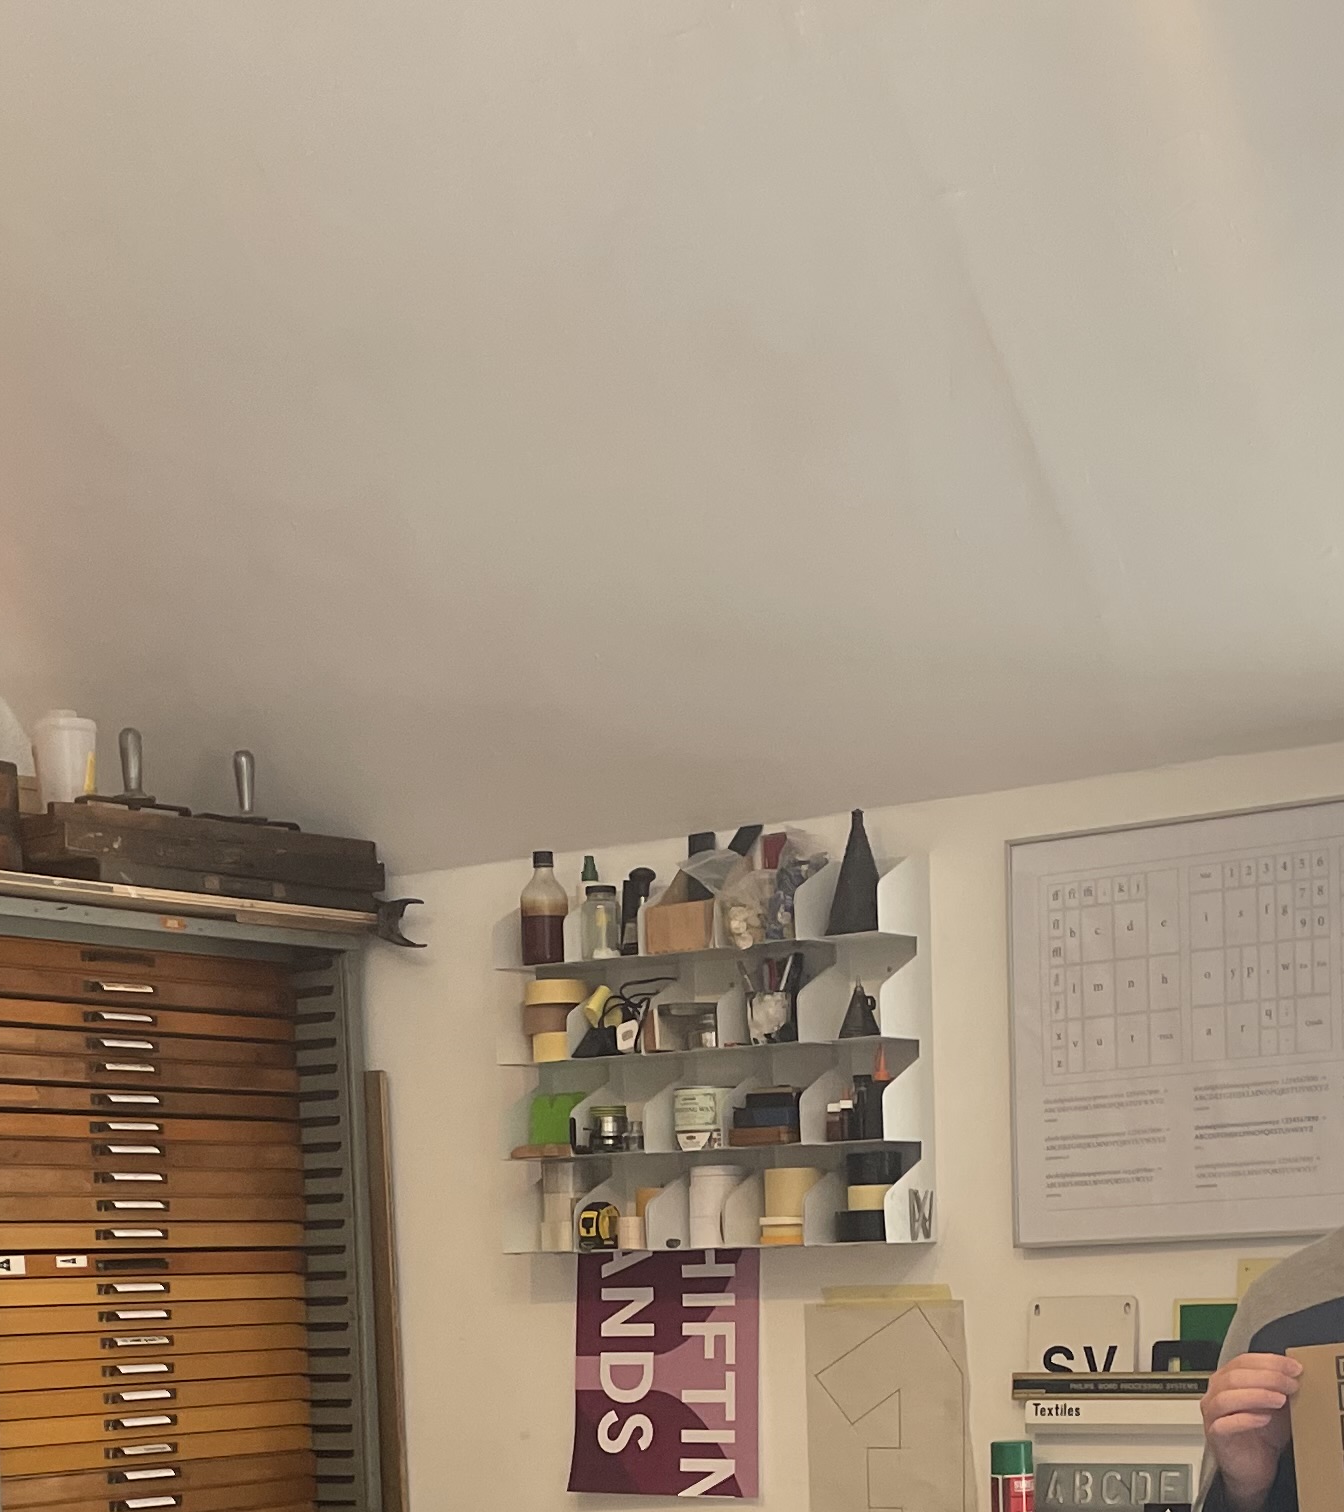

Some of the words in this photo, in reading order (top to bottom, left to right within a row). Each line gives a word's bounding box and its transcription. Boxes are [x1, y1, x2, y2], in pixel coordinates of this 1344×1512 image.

[1098, 1382, 1118, 1390] WORD
[1119, 1382, 1162, 1390] PROCESSING
[1165, 1382, 1198, 1390] SYSTEMS
[1032, 1403, 1081, 1417] Textiles
